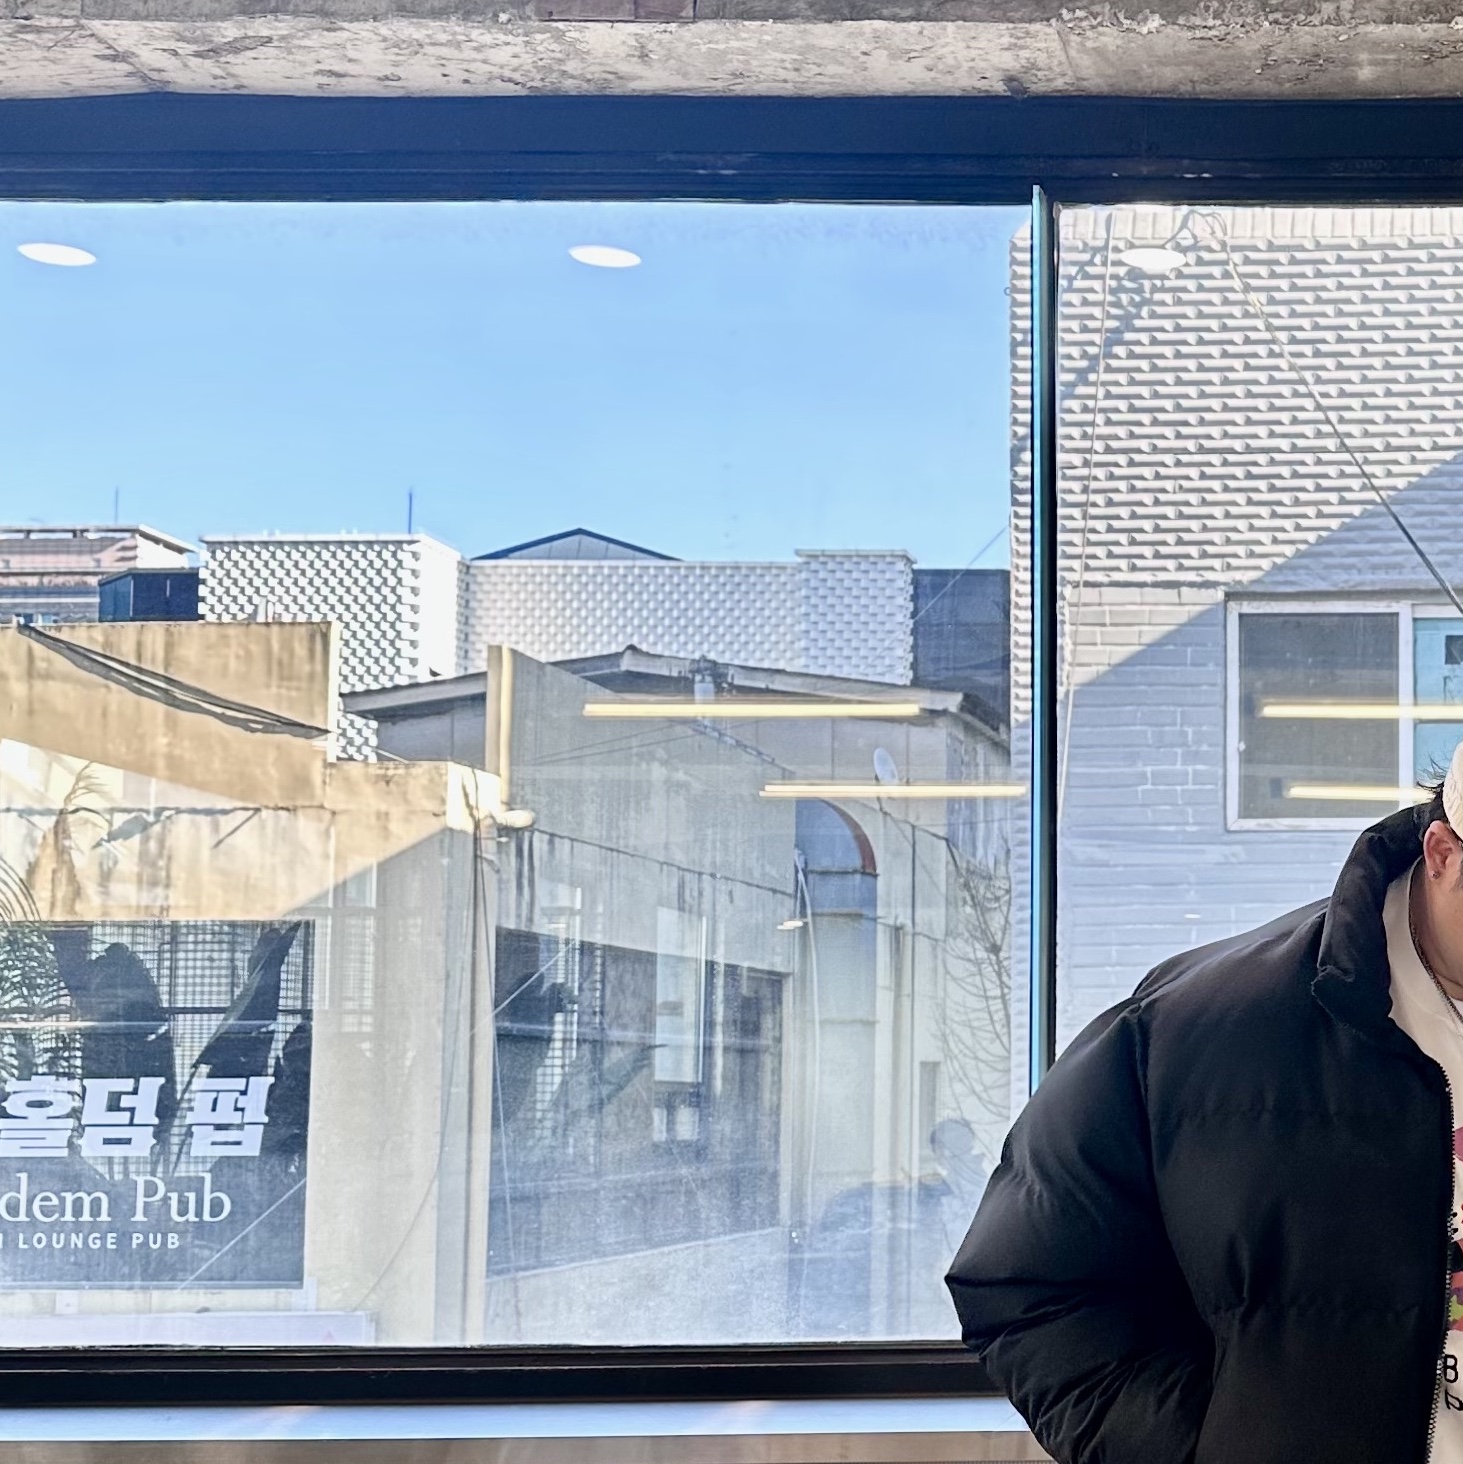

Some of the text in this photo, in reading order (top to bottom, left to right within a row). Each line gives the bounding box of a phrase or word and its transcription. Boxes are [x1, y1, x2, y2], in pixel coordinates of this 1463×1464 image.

[0, 1075, 275, 1157] 홀덤 펍
[0, 1171, 232, 1223] dem Pub
[18, 1232, 118, 1249] LOUNGE
[131, 1232, 181, 1249] PUB
